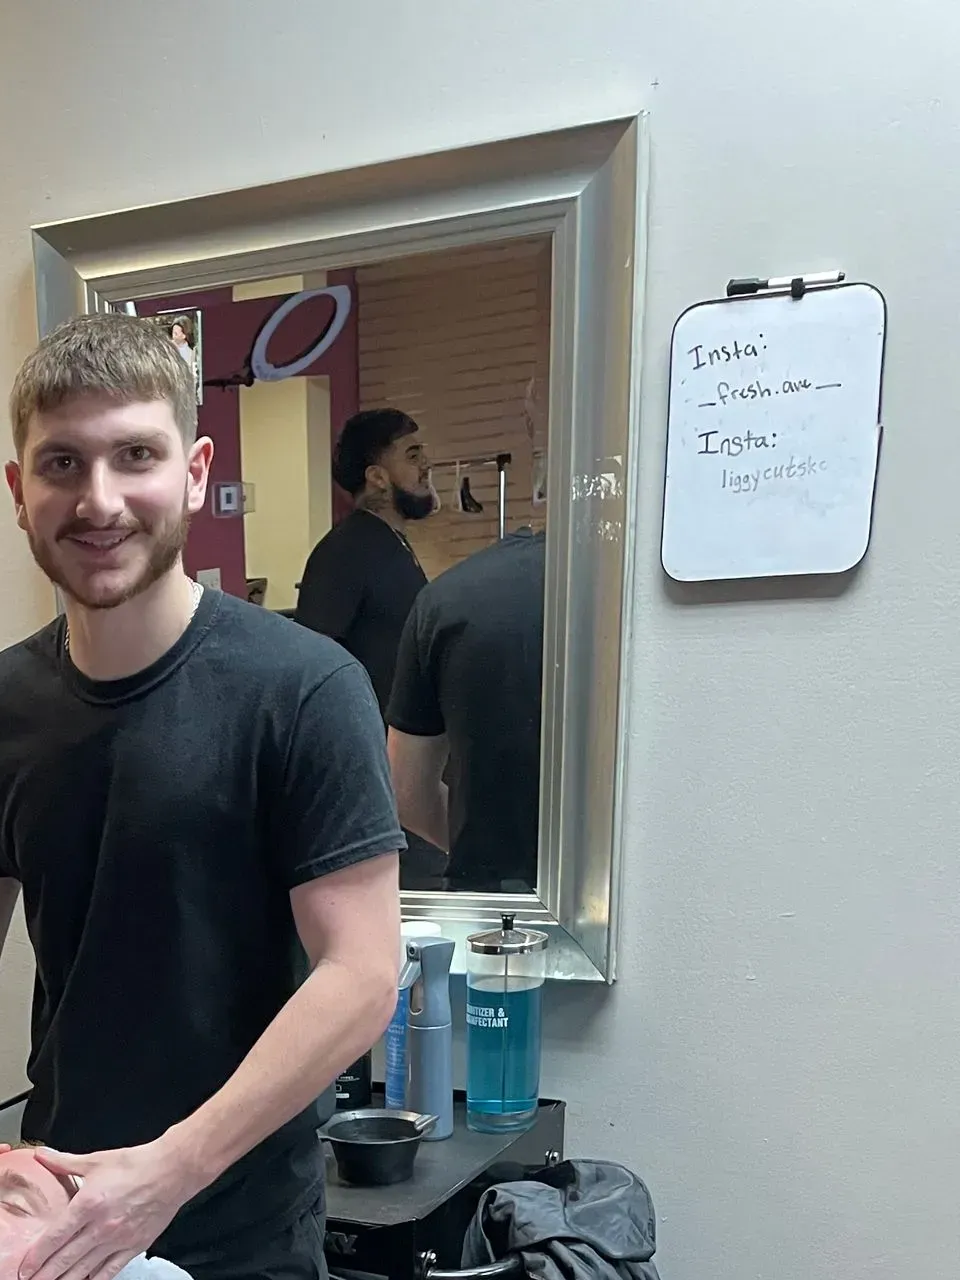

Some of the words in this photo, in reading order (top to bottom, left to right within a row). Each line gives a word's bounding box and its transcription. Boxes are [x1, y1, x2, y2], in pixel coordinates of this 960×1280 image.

[687, 333, 767, 370] Insta:
[697, 431, 778, 457] Insta:
[497, 1007, 505, 1018] &
